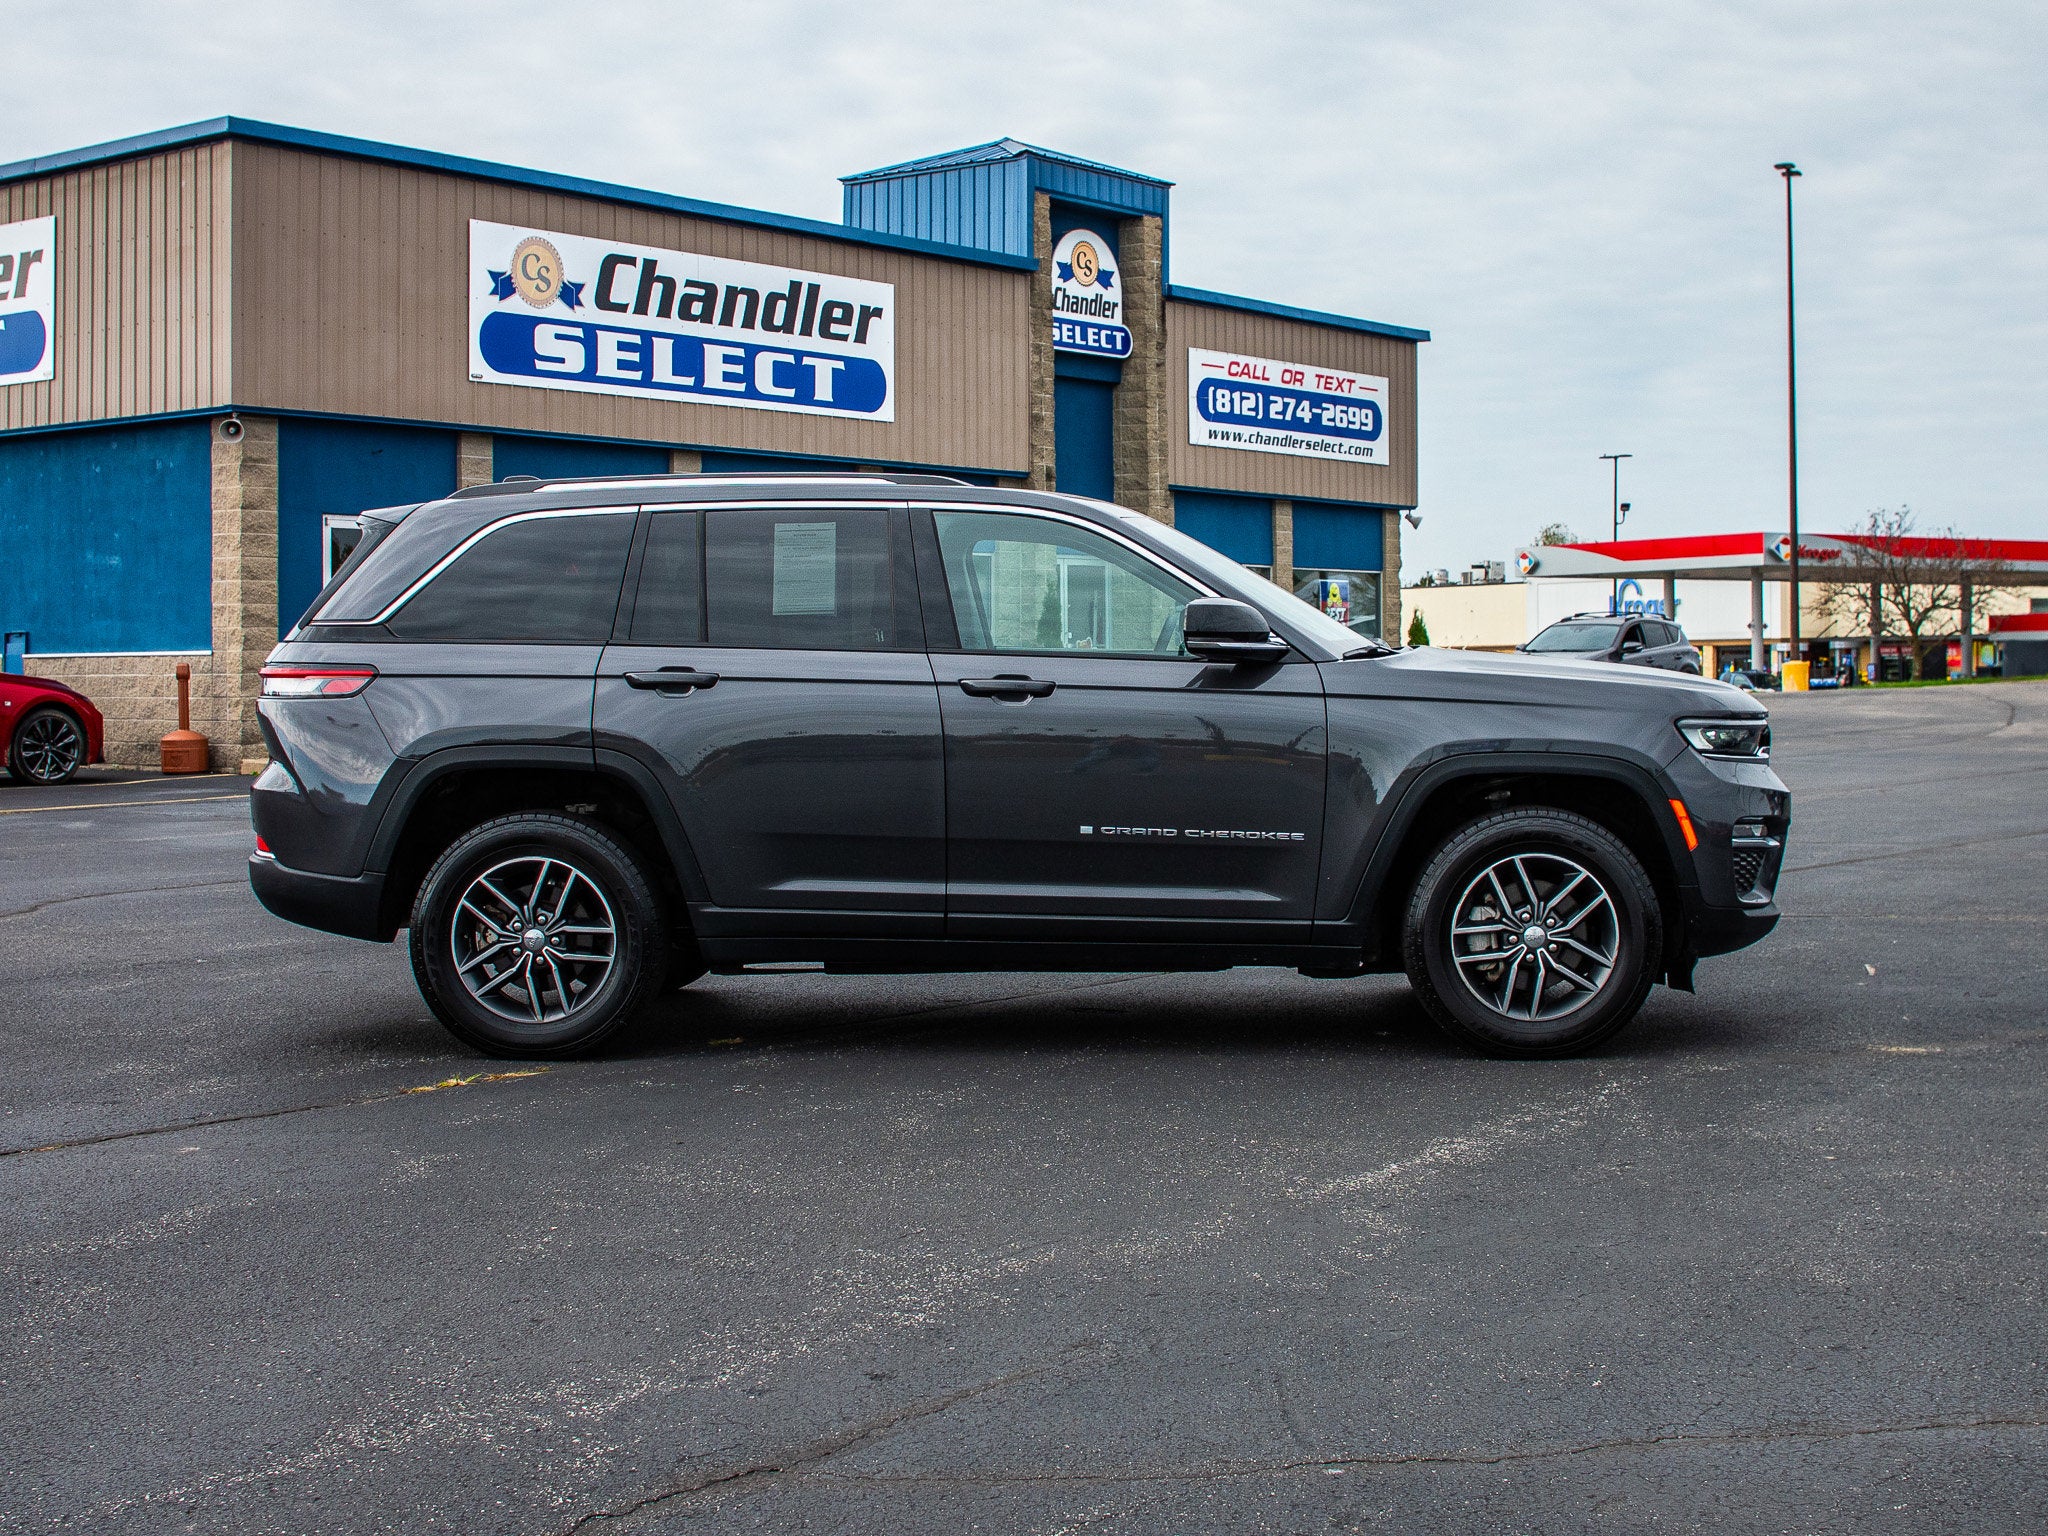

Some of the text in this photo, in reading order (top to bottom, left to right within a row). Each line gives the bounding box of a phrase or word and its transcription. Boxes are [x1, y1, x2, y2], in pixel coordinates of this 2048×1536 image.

[595, 253, 884, 345] Chandler
[1053, 286, 1119, 319] Chandler
[533, 323, 846, 402] SELECT
[1227, 361, 1356, 394] CALL OR TEXT
[1208, 386, 1374, 432] (812) 274-2699
[1208, 428, 1374, 458] www.chandlerselect.com
[1609, 578, 1681, 617] Krog
[1100, 826, 1305, 841] GRAND CHEROKEE
